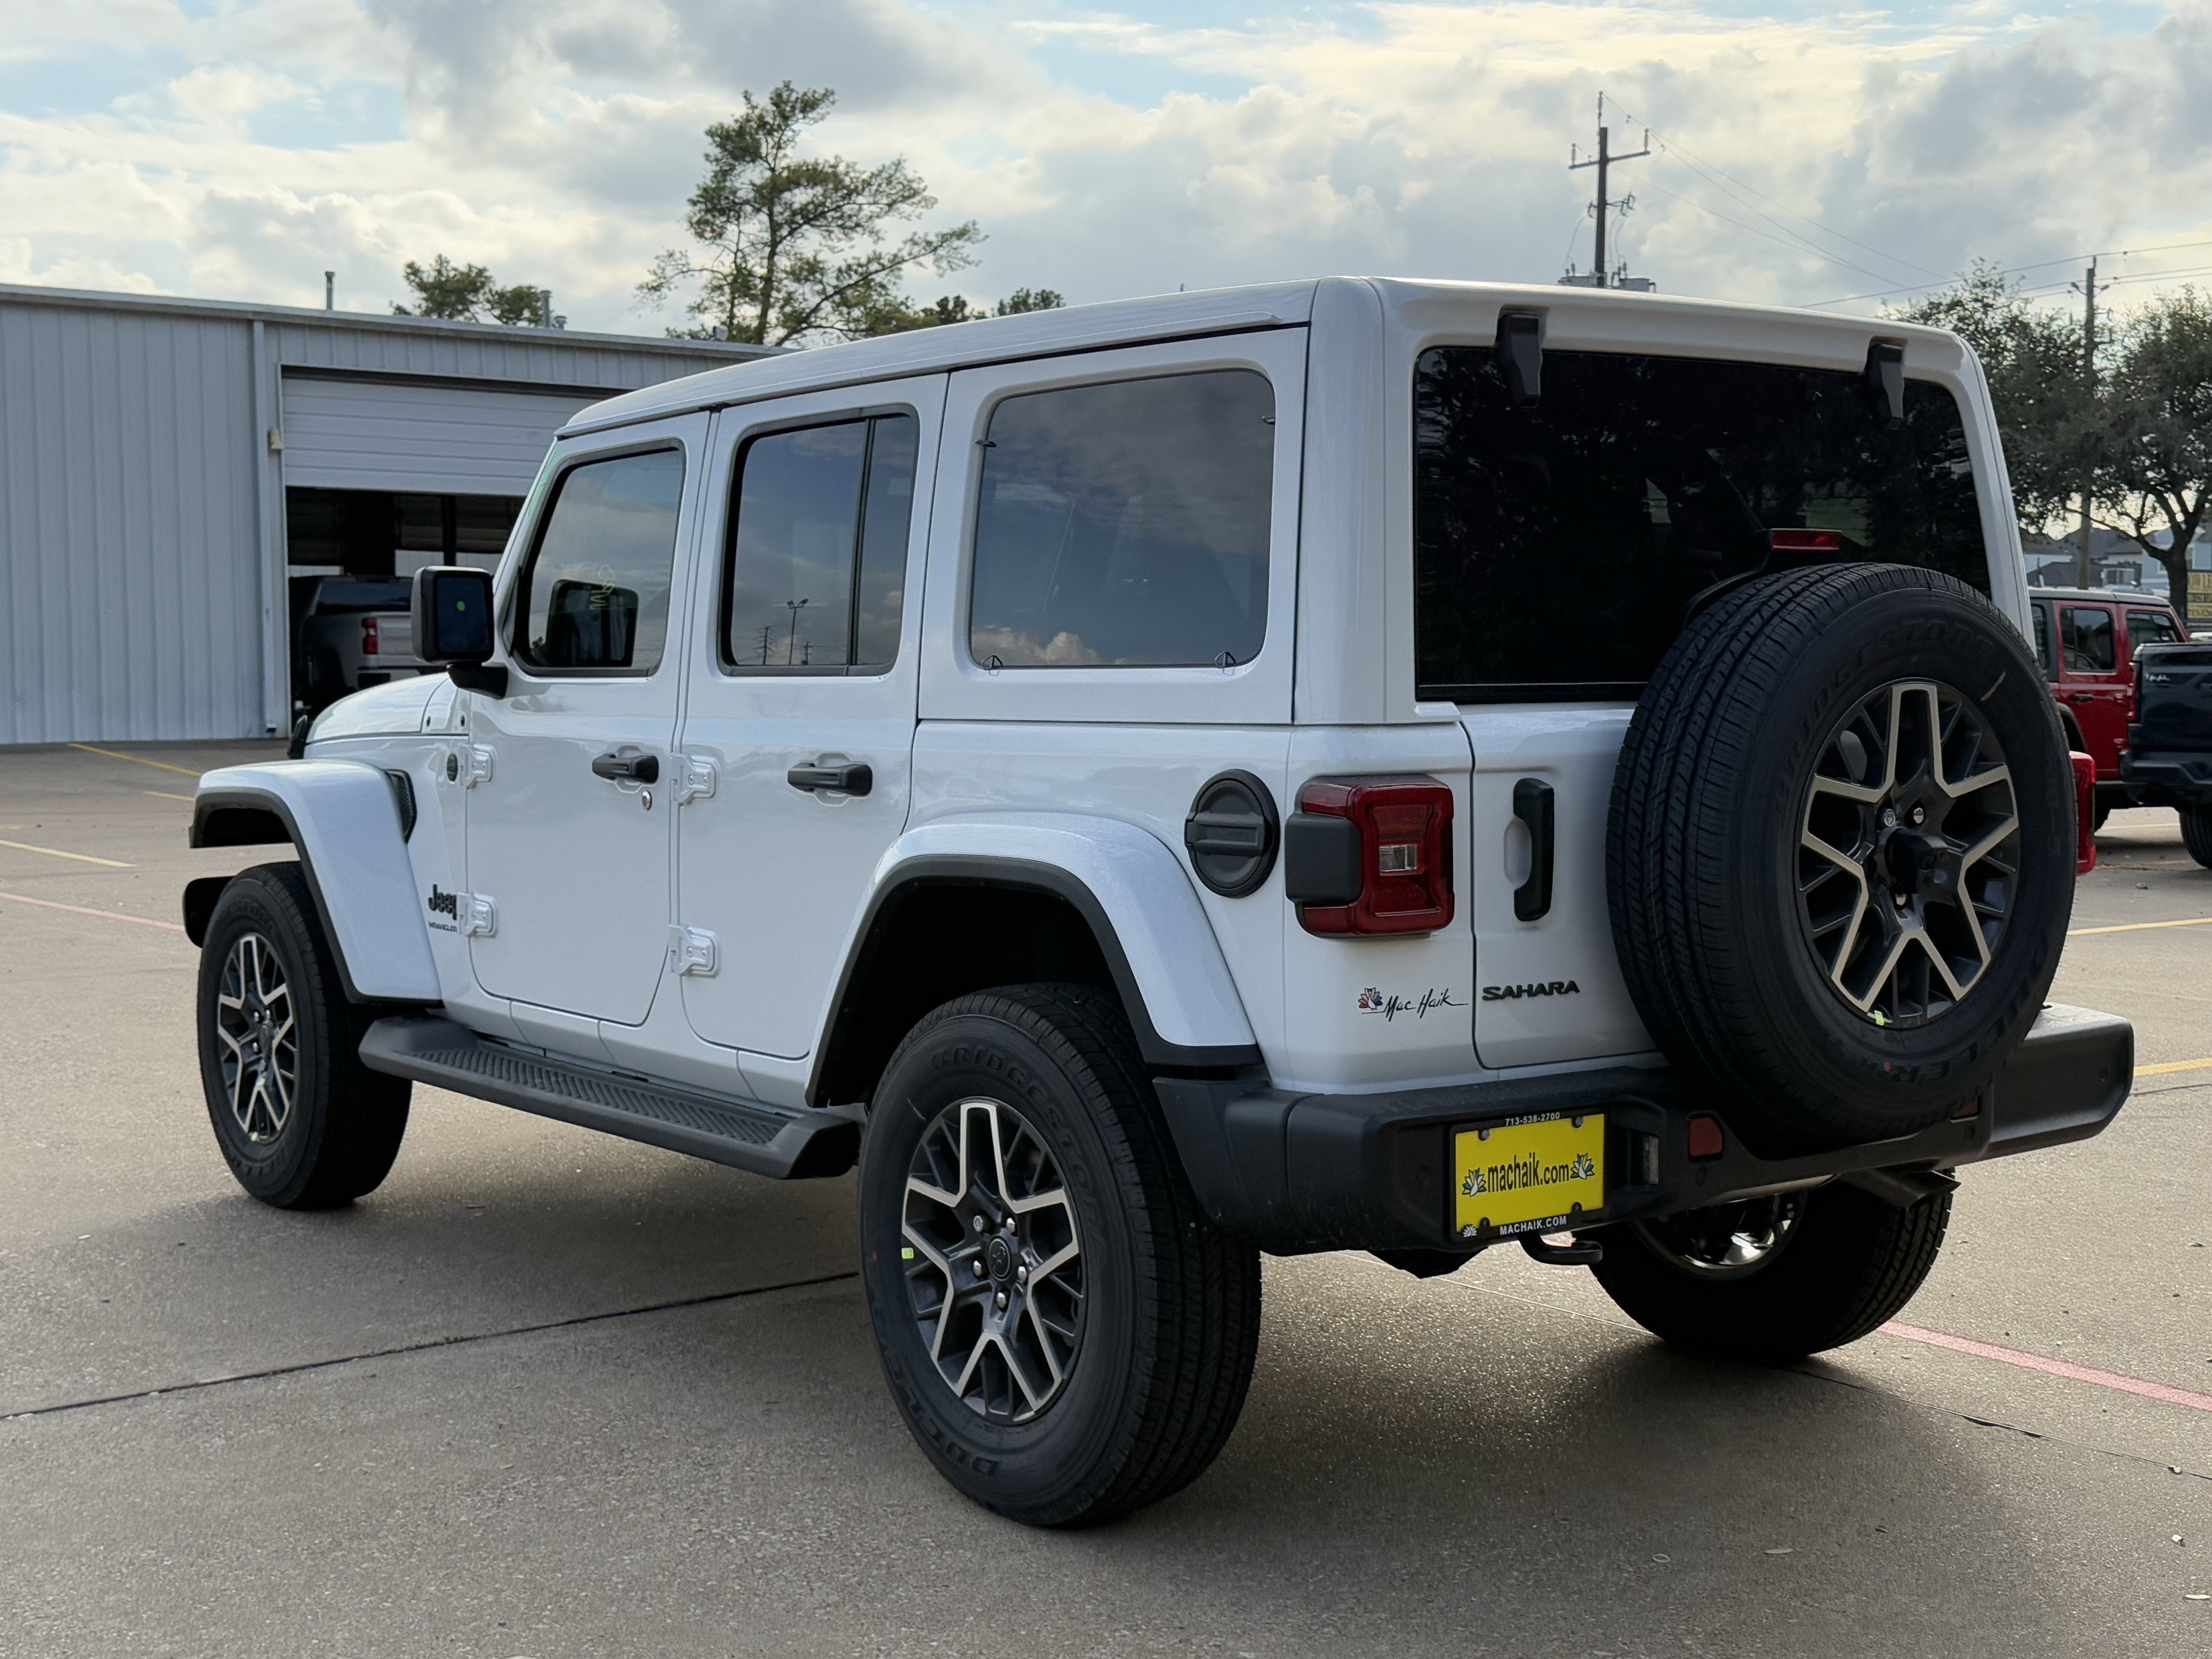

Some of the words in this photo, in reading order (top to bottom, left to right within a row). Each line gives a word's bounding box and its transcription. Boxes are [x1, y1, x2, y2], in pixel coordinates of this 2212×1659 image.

[1482, 980, 1580, 1001] SAHARA
[1384, 995, 1417, 1022] Mac
[1416, 988, 1469, 1019] Haik
[1505, 1111, 1560, 1127] 713-538-2700
[1487, 1152, 1570, 1193] machaik.com
[1499, 1215, 1567, 1235] MACHAIK.COM
